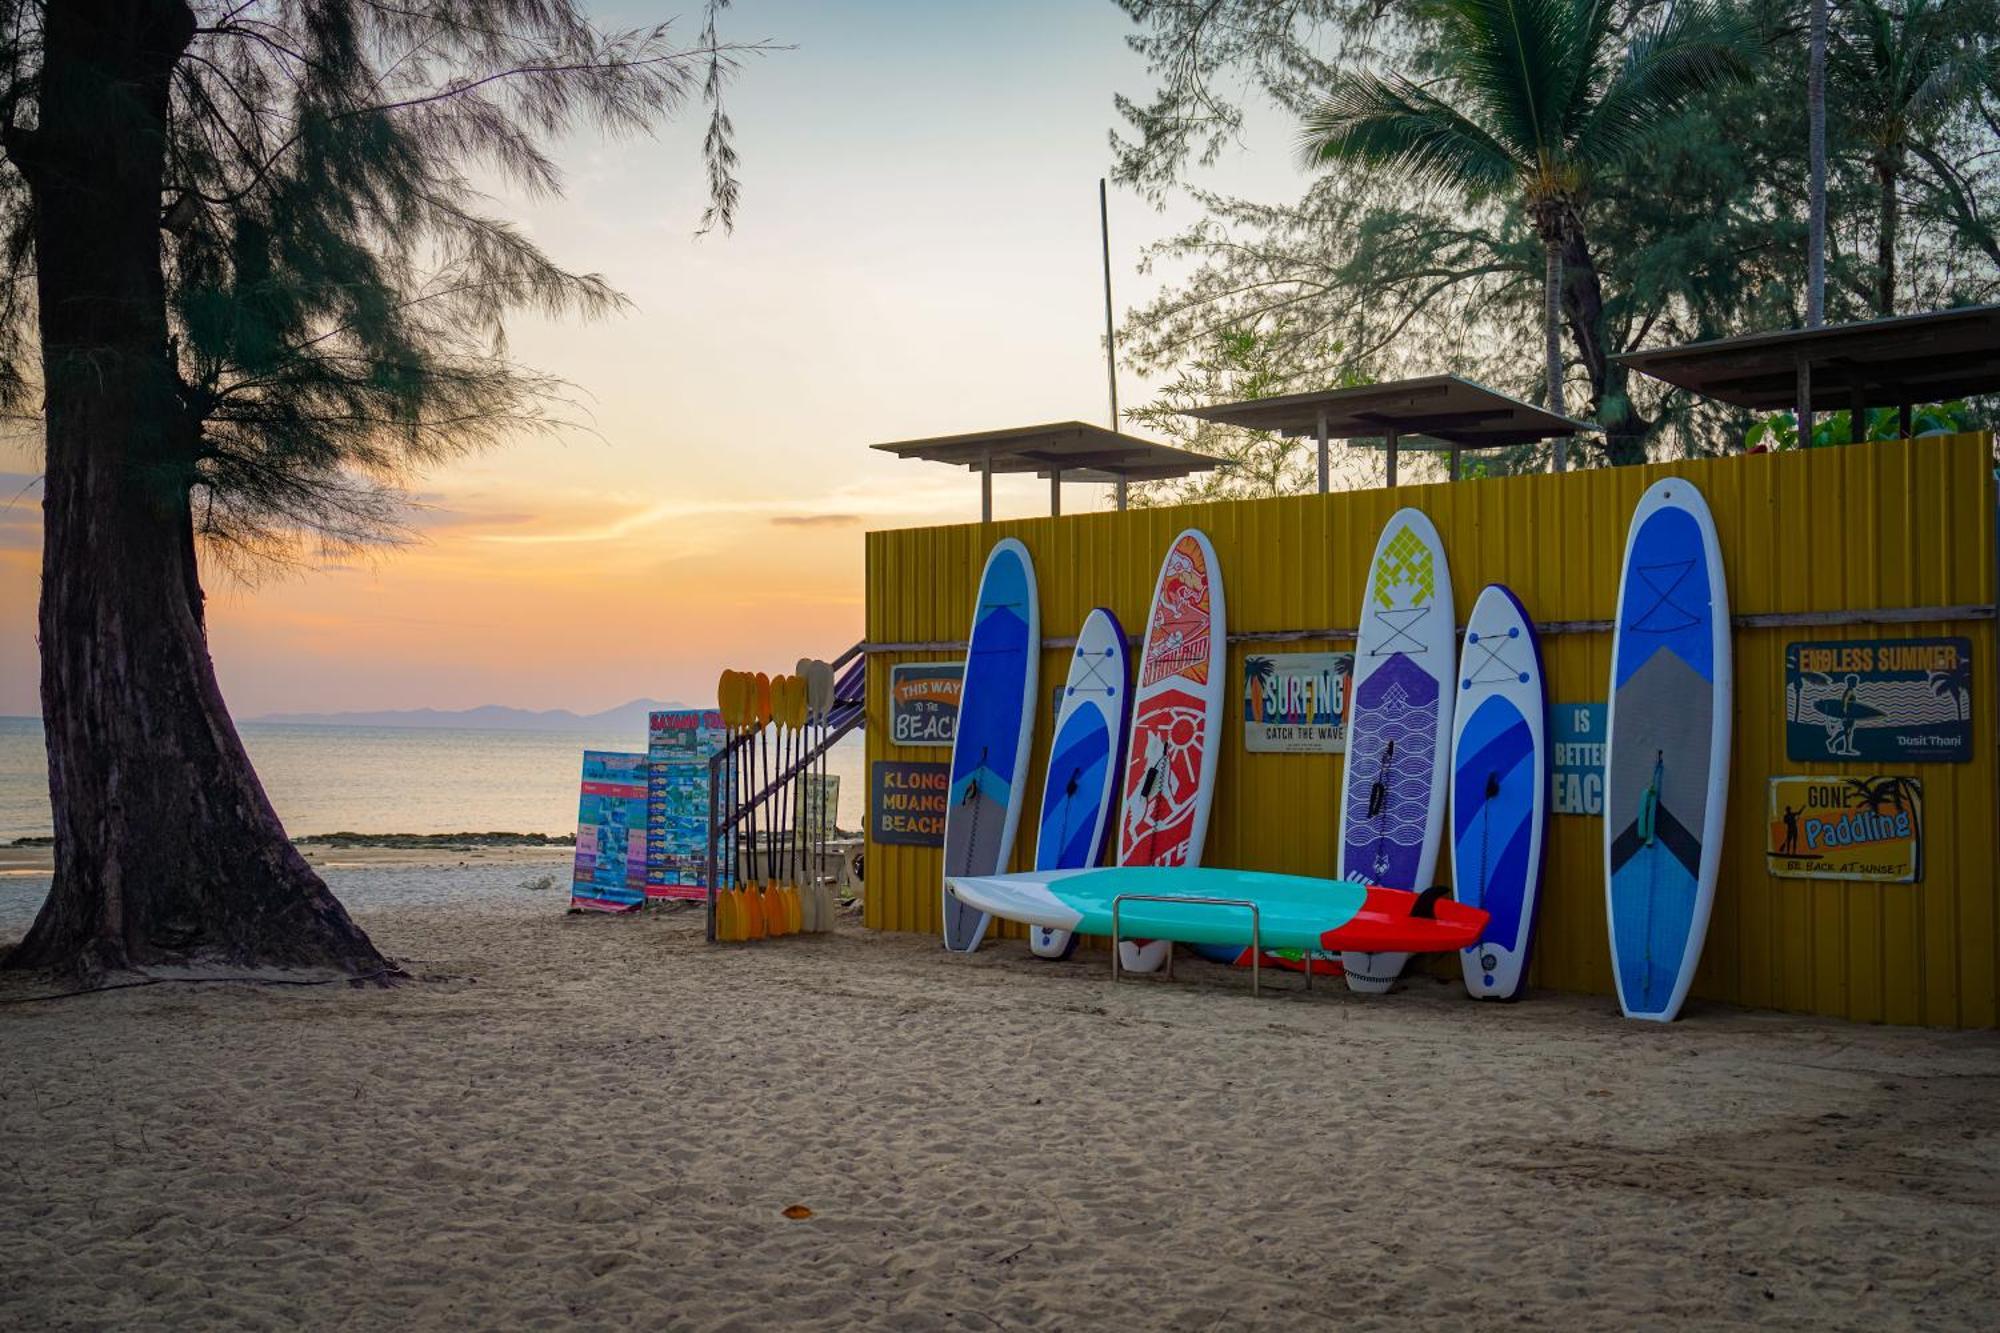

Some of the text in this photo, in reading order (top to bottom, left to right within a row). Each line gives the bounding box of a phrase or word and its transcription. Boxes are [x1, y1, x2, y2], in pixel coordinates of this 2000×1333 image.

[1800, 646, 1957, 673] ENDLESS SUMMER
[902, 680, 961, 699] THIS WAY
[1266, 674, 1344, 716] SURFING
[913, 702, 939, 712] TO THE
[1573, 709, 1591, 733] IS
[1266, 727, 1344, 740] CATCH THE WAVE
[1897, 735, 1961, 747] Dusit Thani
[884, 771, 948, 790] KLONG
[883, 794, 946, 811] MUANG
[1808, 786, 1852, 808] GONE
[881, 815, 945, 834] BEACH
[1804, 809, 1911, 849] Paddling
[1787, 861, 1907, 874] BE BACK AT SUNSET
